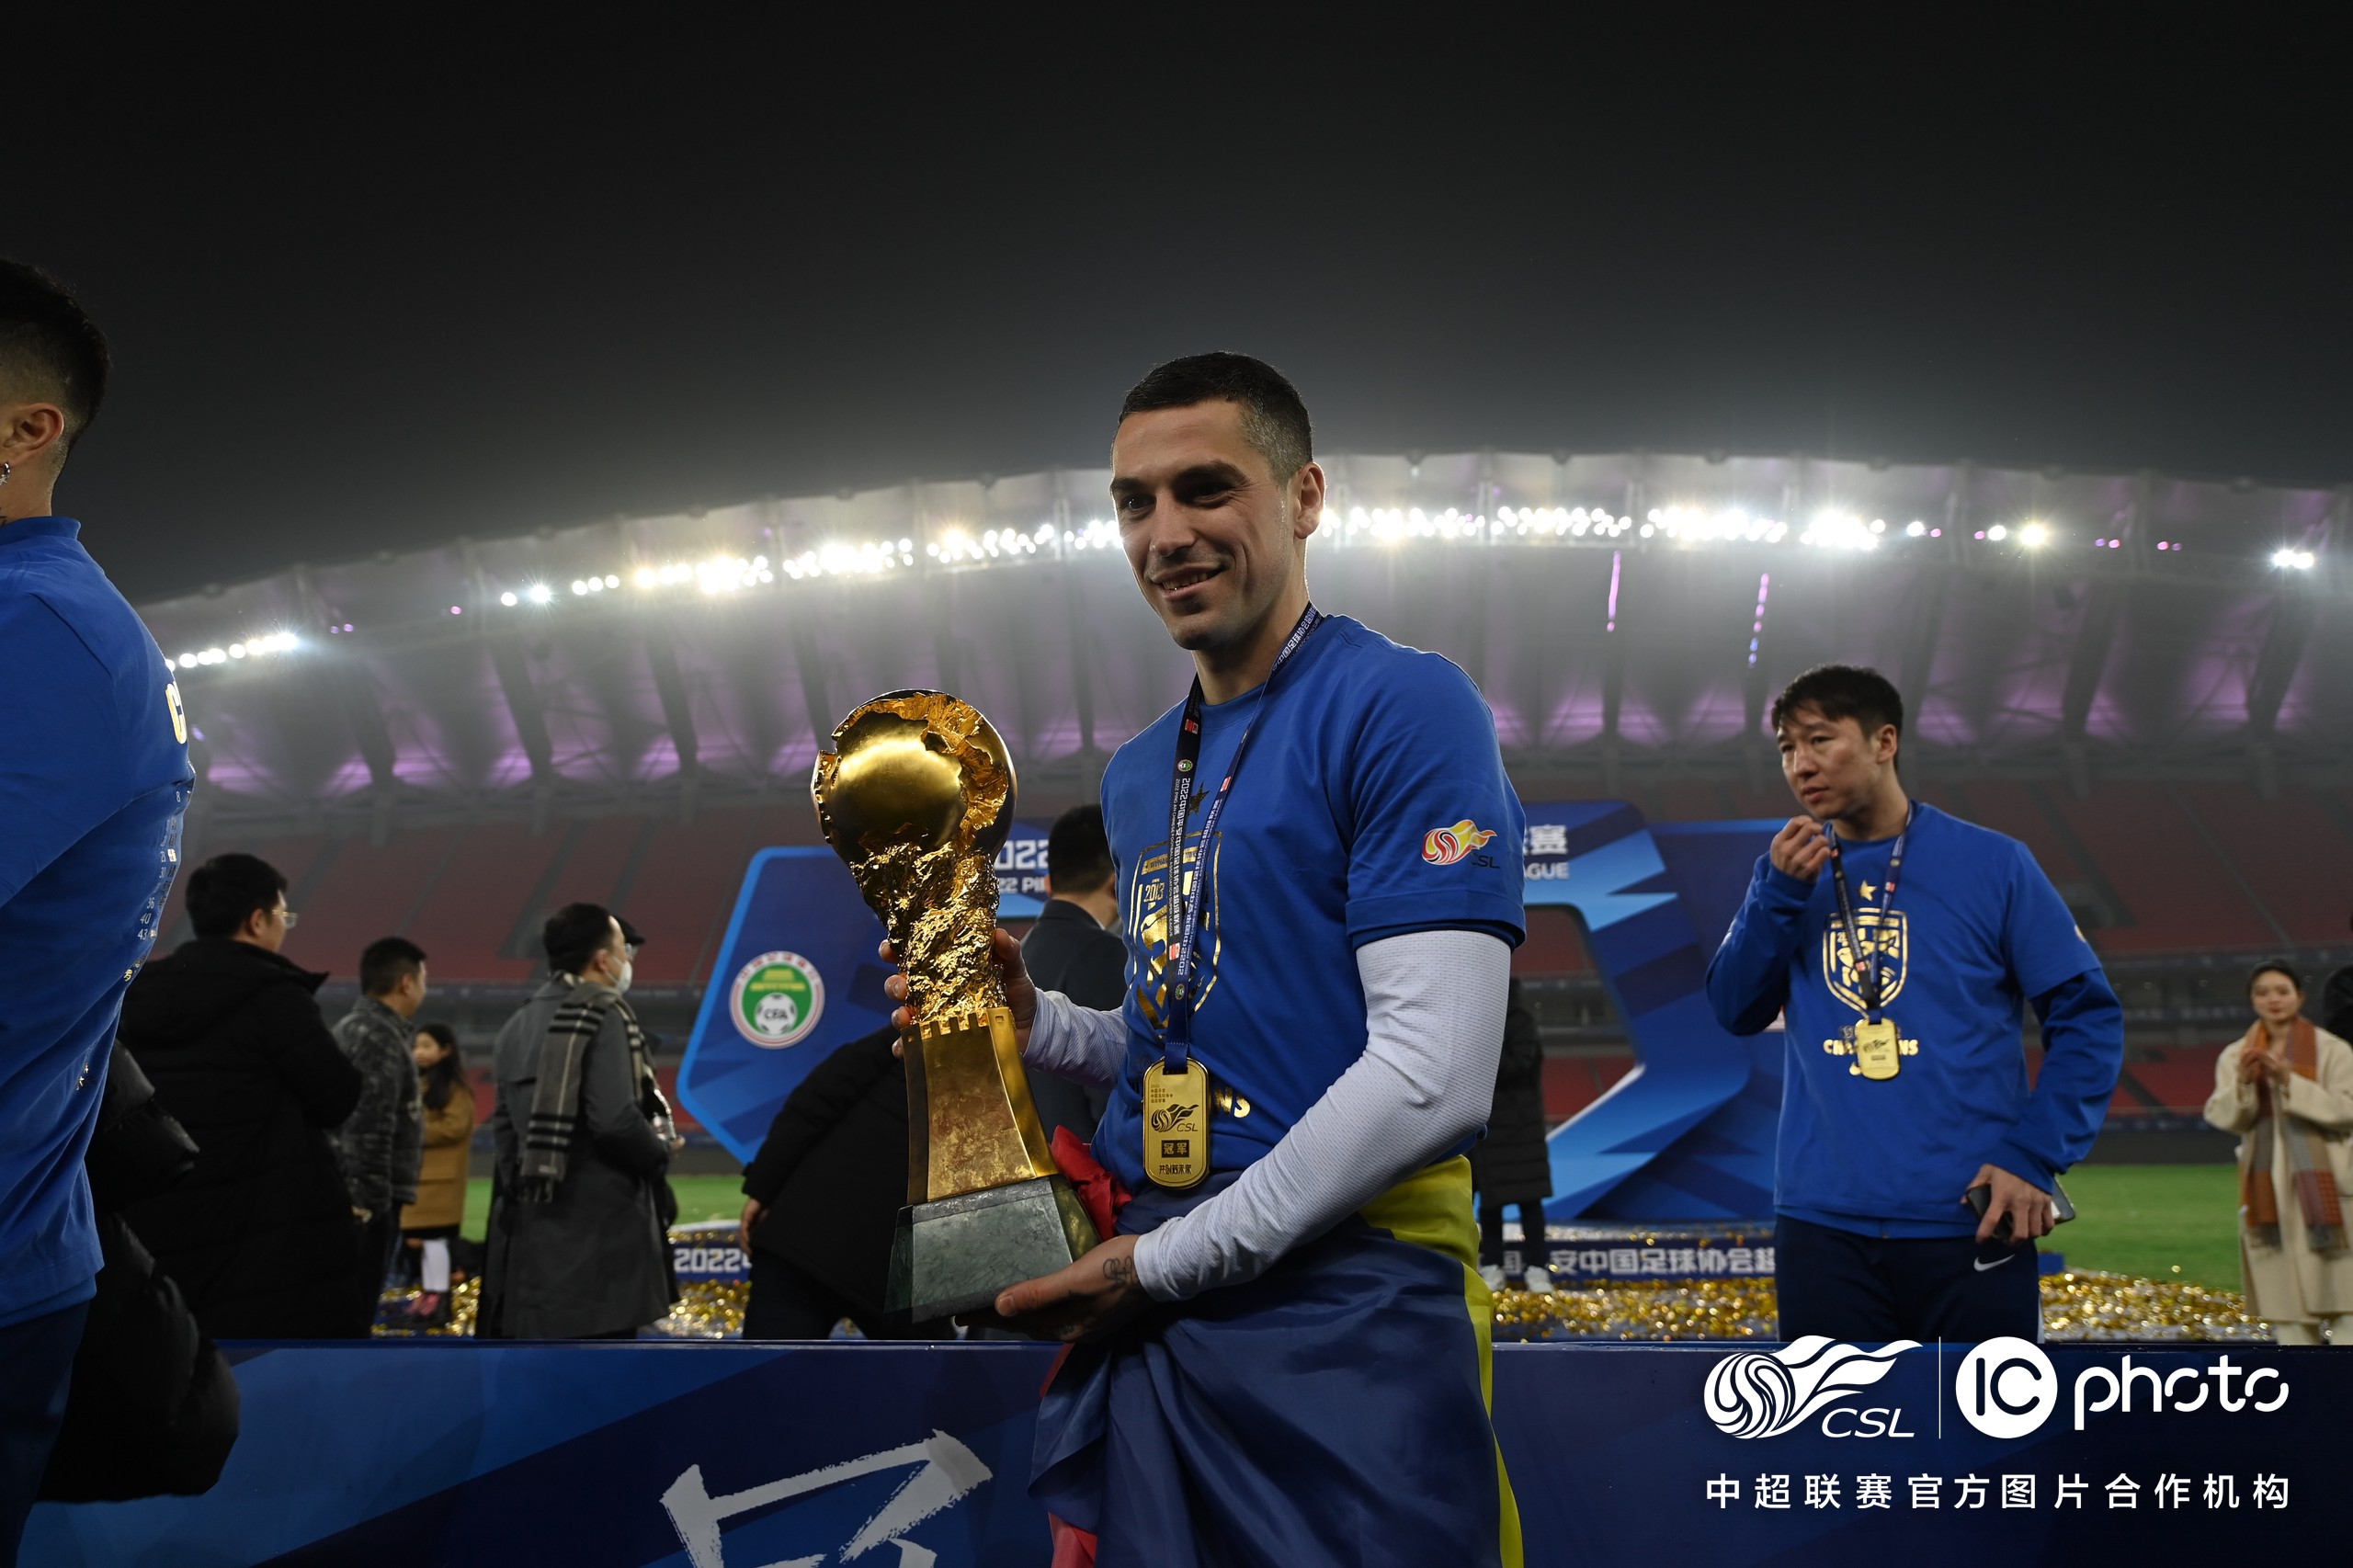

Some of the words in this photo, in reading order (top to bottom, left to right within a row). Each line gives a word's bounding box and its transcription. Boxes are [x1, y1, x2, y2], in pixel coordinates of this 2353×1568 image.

[1143, 882, 1165, 902] 2013
[140, 913, 152, 924] 40
[137, 928, 148, 940] 43
[764, 1008, 788, 1020] CFA
[1214, 1087, 1251, 1119] NS
[1176, 1122, 1199, 1132] CSL
[1164, 1142, 1188, 1154] 冠军
